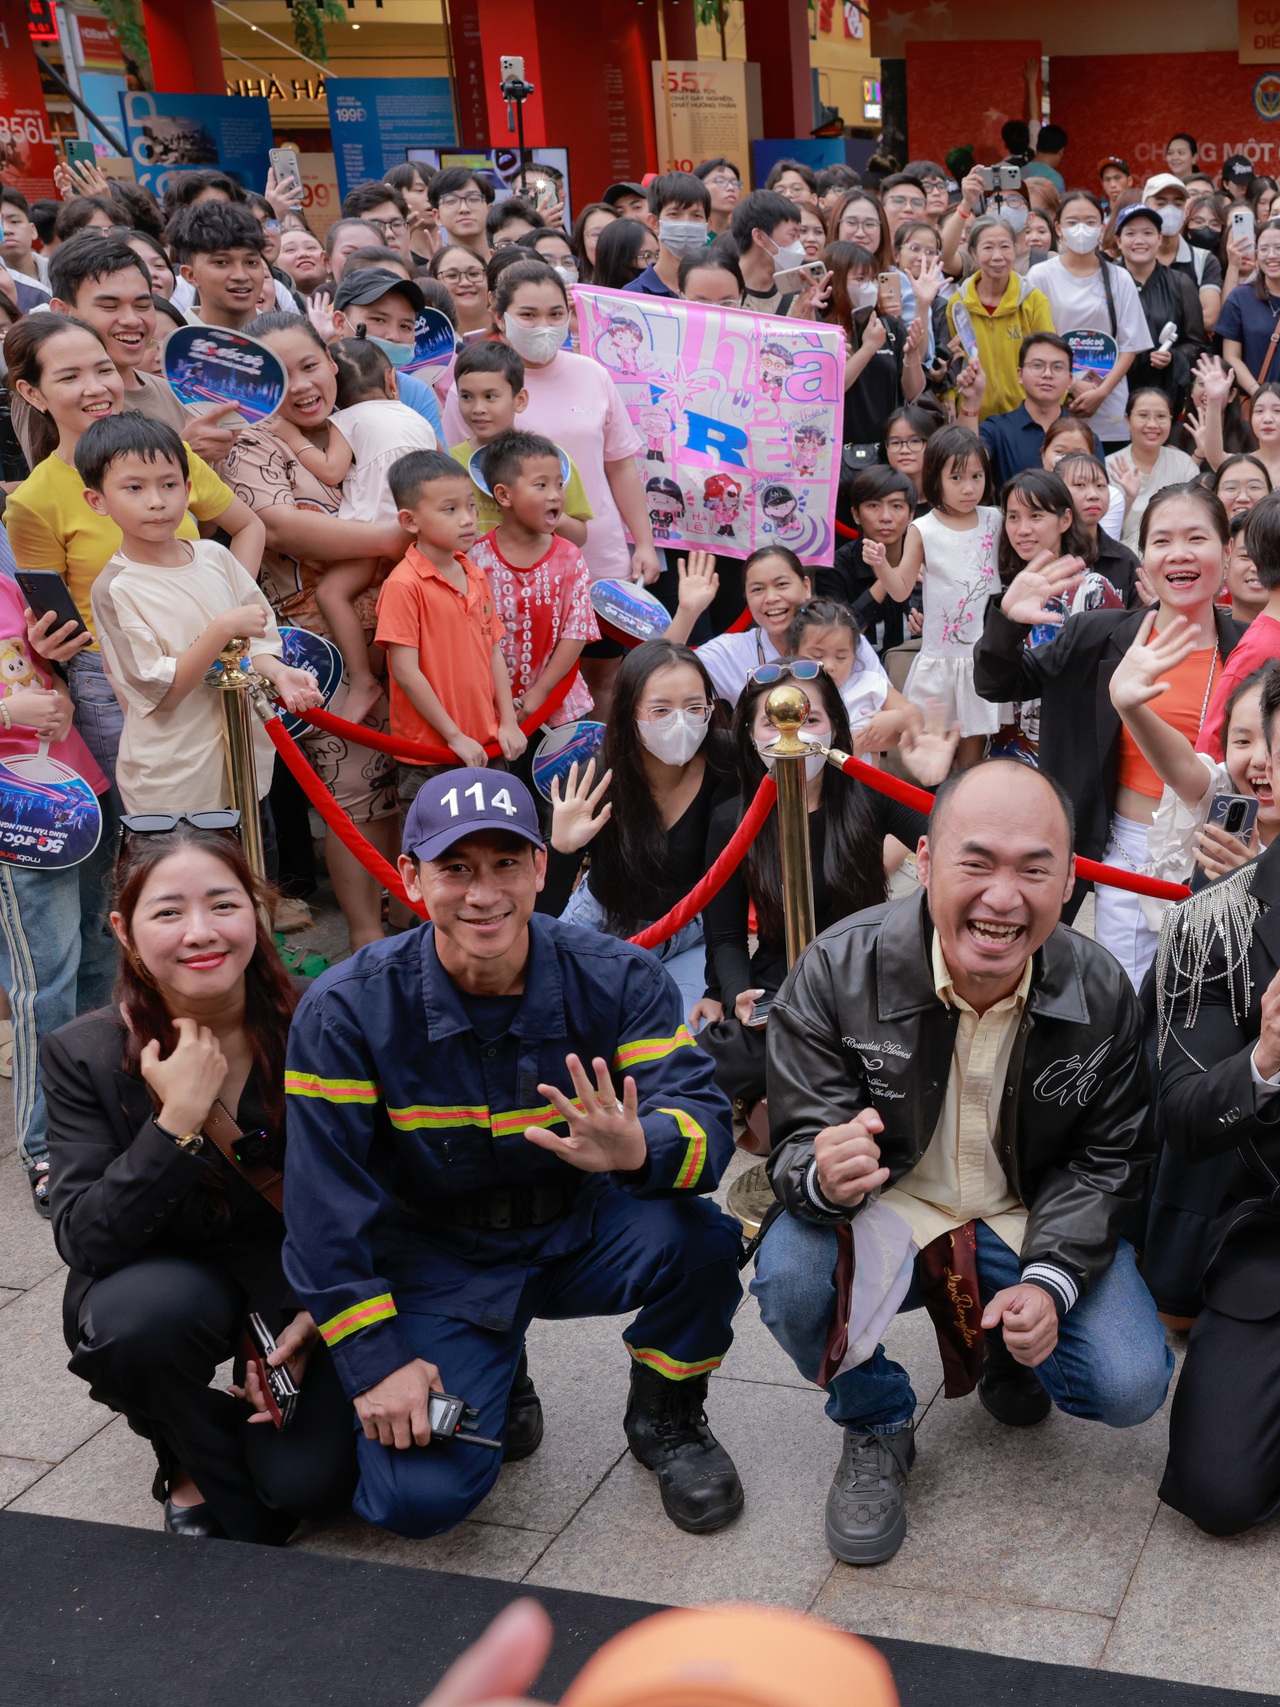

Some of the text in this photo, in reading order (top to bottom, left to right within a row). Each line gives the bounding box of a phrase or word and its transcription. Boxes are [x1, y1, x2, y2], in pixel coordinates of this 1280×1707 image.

[226, 72, 288, 101] NHÀ
[440, 782, 518, 818] 114
[48, 831, 68, 839] NÂNG
[881, 1040, 912, 1060] Homes
